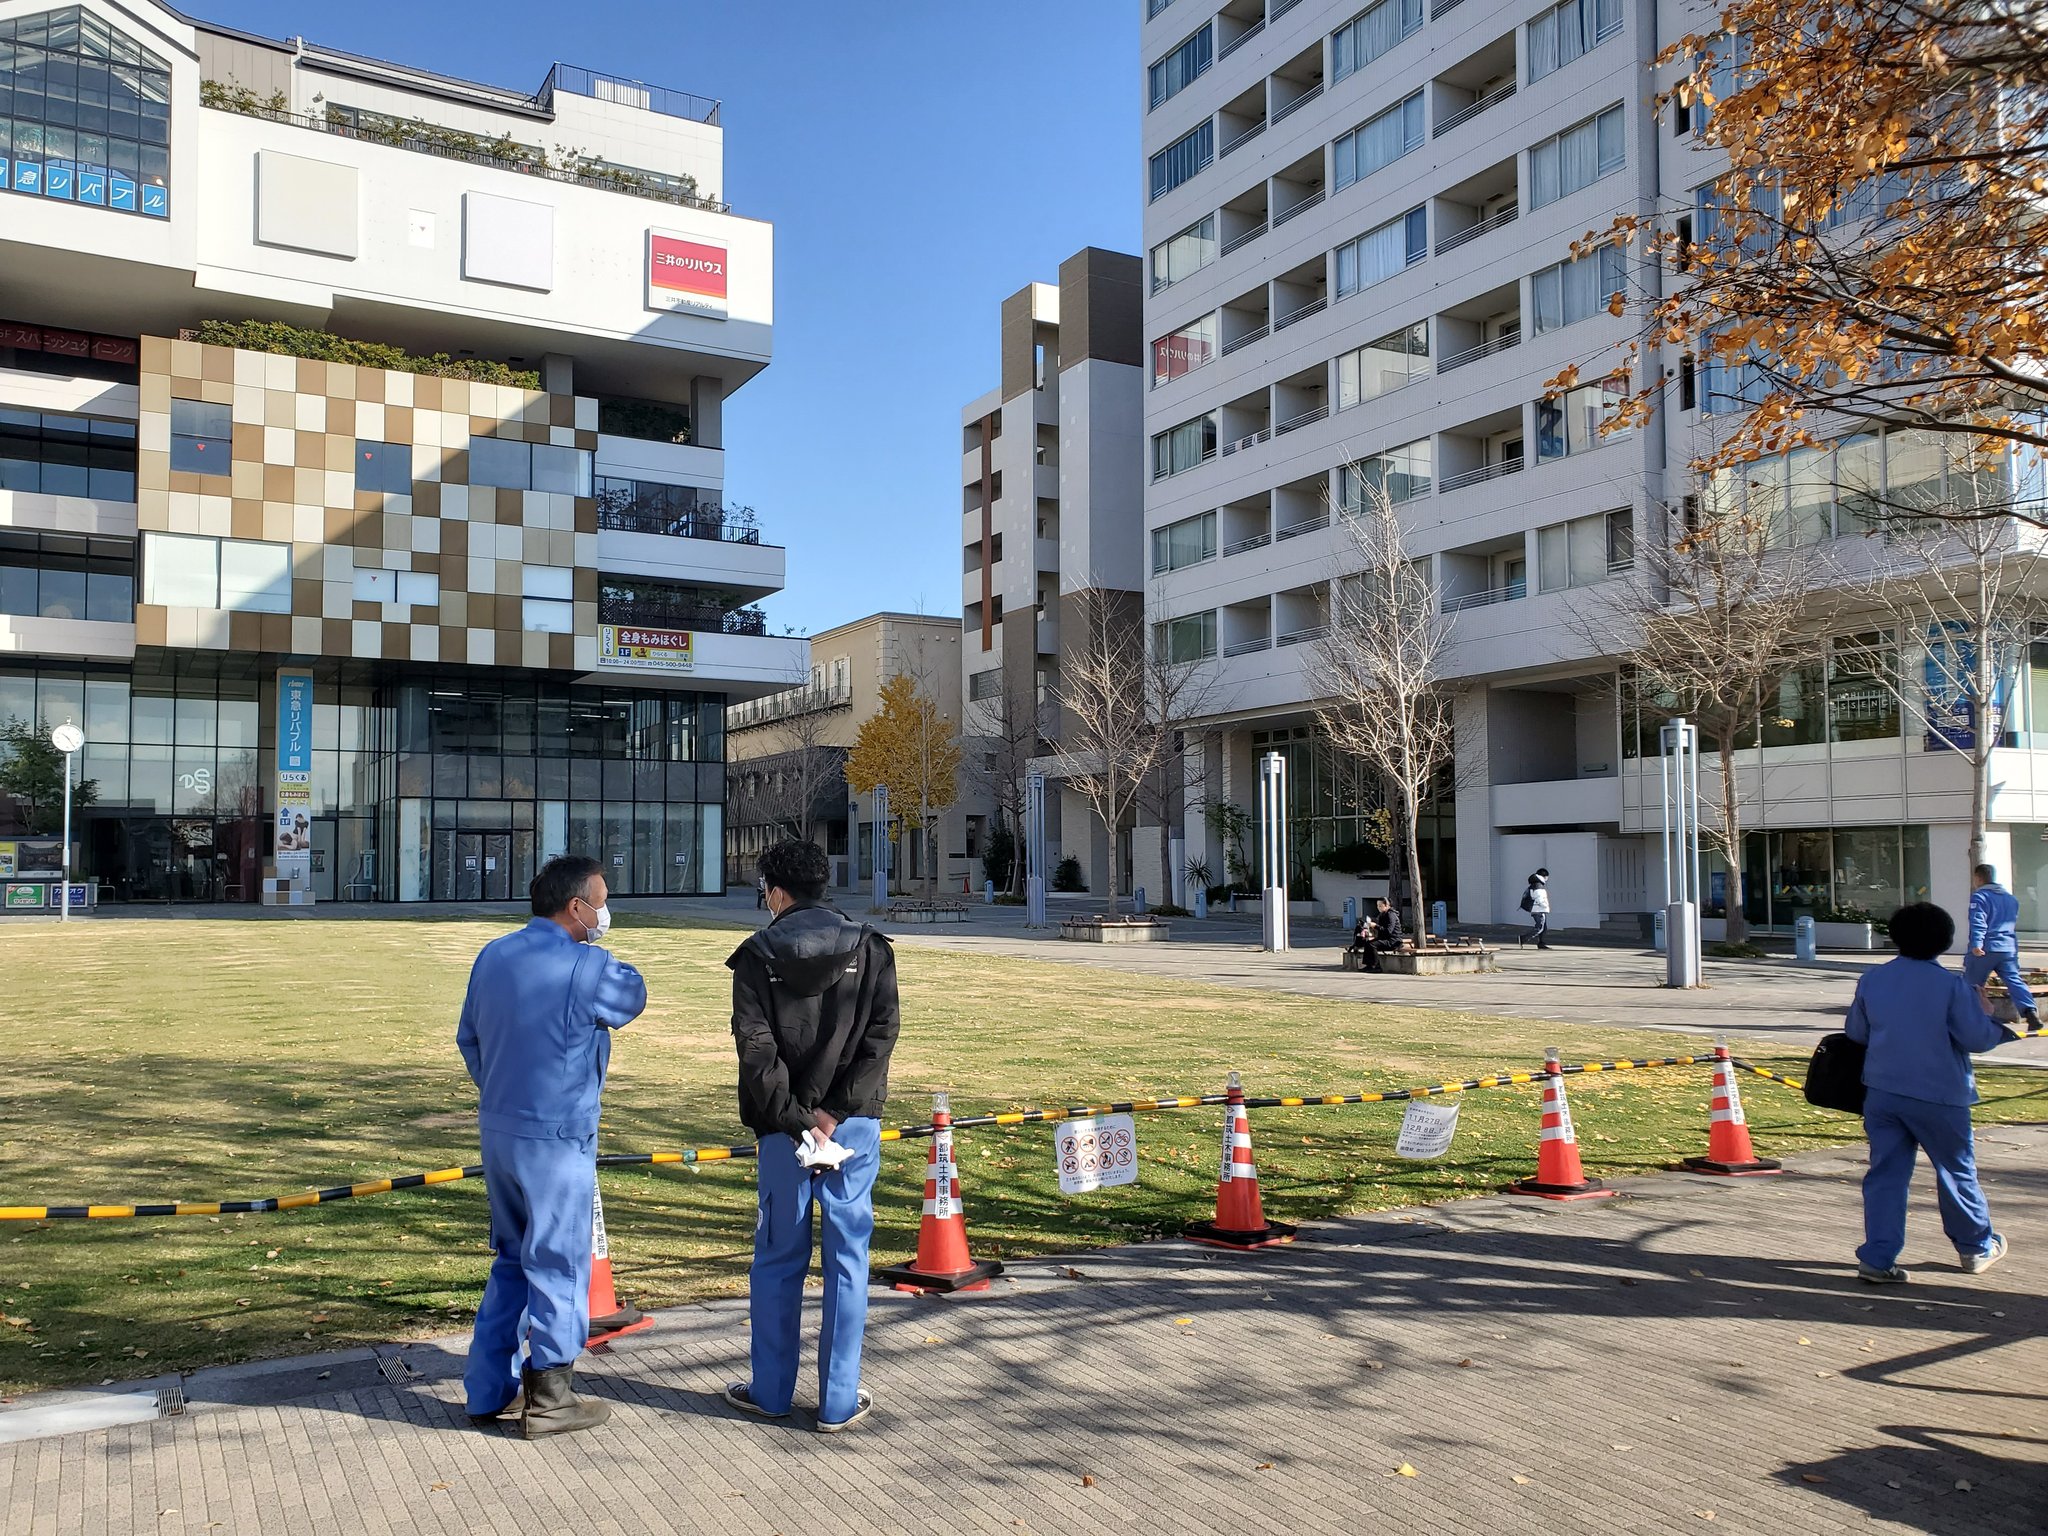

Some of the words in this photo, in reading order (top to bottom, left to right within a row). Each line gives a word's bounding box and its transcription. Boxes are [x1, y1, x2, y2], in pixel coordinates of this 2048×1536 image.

[655, 252, 723, 276] 三井のリハウス
[620, 630, 687, 647] 全身もみほぐし
[620, 648, 631, 656] 1F
[289, 689, 302, 752] 東急リバブル
[938, 1142, 949, 1217] 都筑土木事務所
